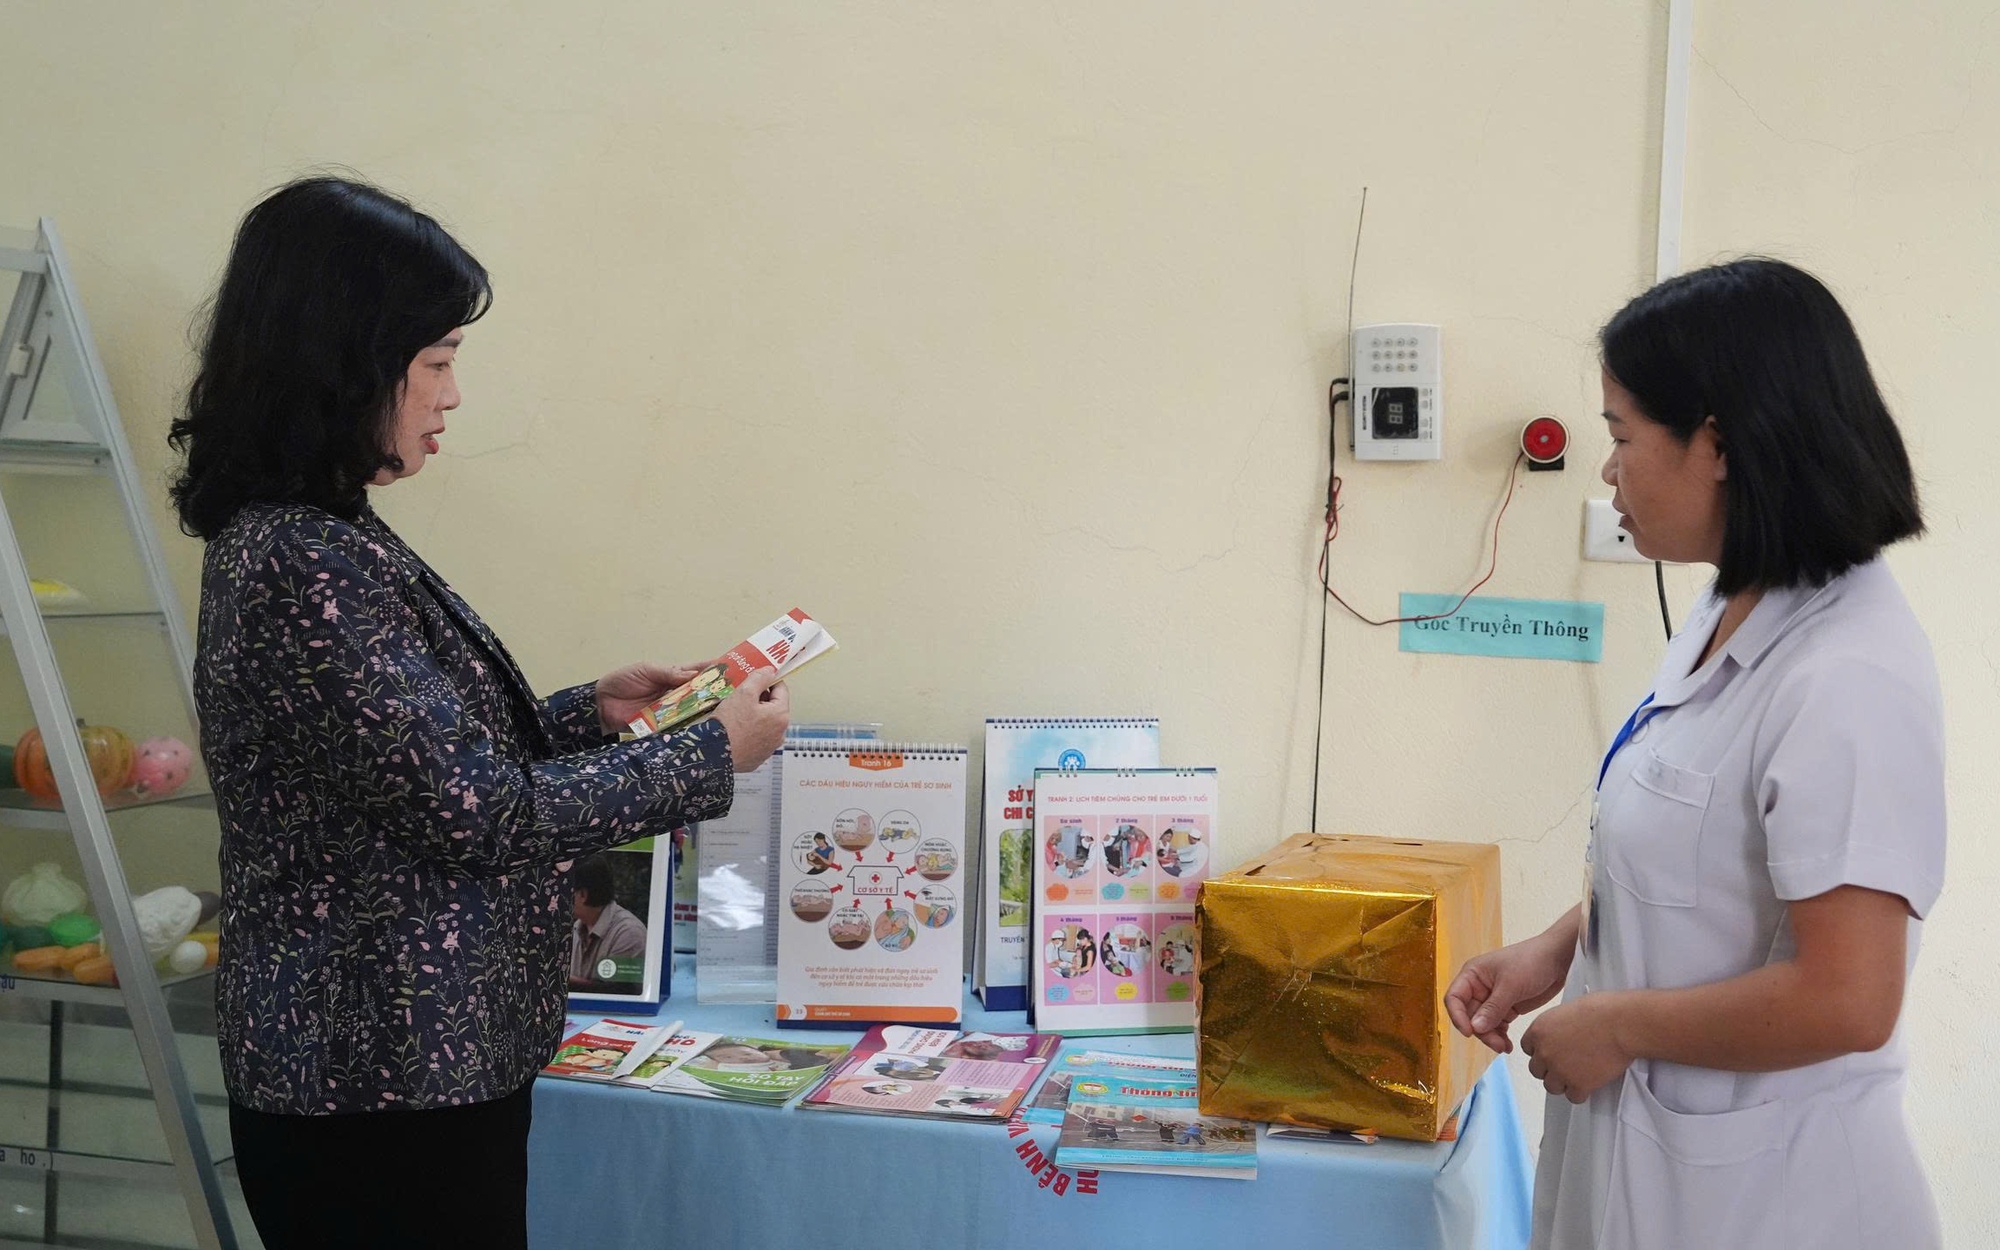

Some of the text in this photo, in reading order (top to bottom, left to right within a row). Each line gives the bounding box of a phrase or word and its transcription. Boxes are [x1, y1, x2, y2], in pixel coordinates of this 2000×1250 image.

[1456, 615, 1522, 637] Truyền
[1529, 619, 1589, 642] Thông
[1008, 784, 1034, 802] SỞ Y
[1004, 807, 1023, 820] CHI
[1015, 1138, 1072, 1197] BỆNH
